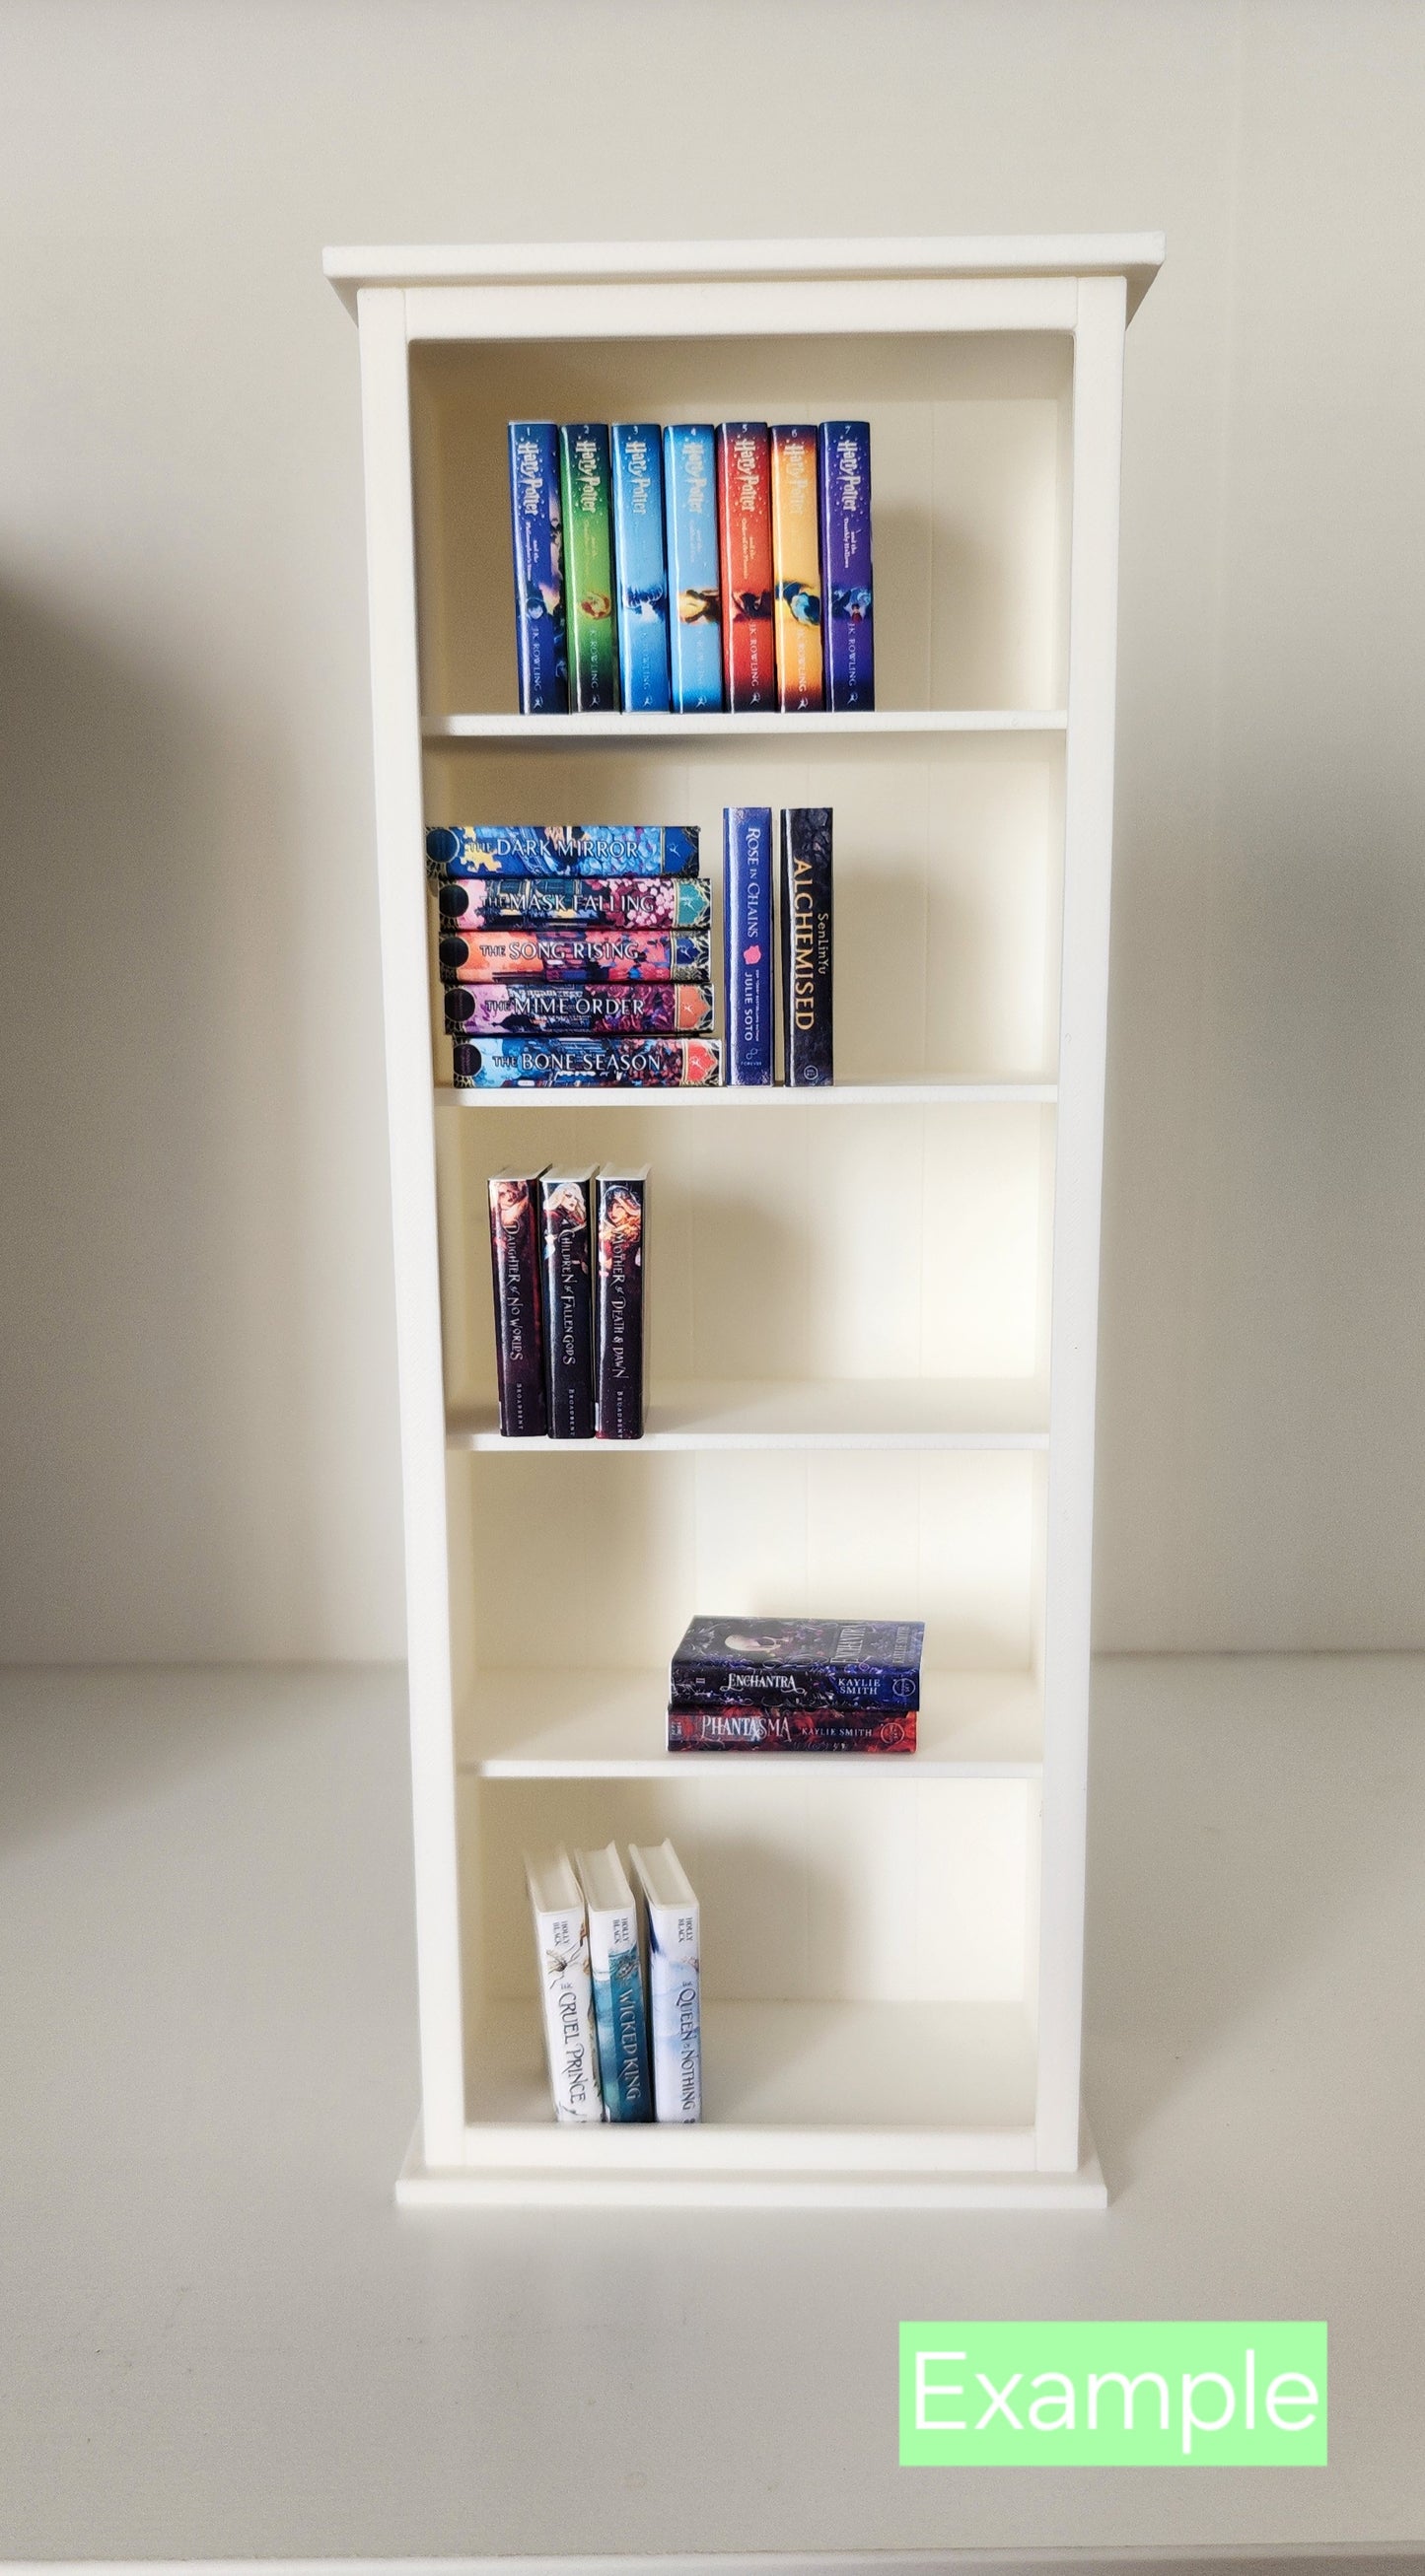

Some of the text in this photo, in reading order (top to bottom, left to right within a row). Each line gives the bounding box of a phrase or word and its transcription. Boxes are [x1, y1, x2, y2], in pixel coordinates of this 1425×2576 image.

[583, 425, 590, 435] 2
[633, 426, 639, 435] 3
[690, 427, 696, 436] 4
[743, 424, 748, 433] 5
[791, 429, 797, 439] 6
[845, 426, 851, 435] 7
[517, 442, 543, 515] Harry Potter
[575, 441, 597, 479] Harry
[625, 441, 647, 478] Harry
[734, 439, 759, 512] Harry Potter
[837, 440, 861, 512] Harry Potter
[575, 476, 601, 514] Potter
[626, 477, 651, 515] Potter
[532, 643, 542, 691] ROWLING
[750, 642, 759, 687] ROWLING
[848, 642, 857, 687] ROWLING
[496, 839, 552, 857] DARK
[556, 840, 640, 858] MIRROR
[746, 827, 761, 866] ROSE
[480, 893, 655, 912] THE MASK FALLING
[747, 882, 760, 939] CHAINS
[480, 941, 639, 960] THE SONG RISING
[793, 856, 816, 1031] ALCHEMISED
[817, 913, 829, 975] SenLinYu
[485, 1000, 510, 1012] THE
[513, 998, 569, 1015] MIME
[575, 998, 644, 1015] ORDER
[744, 972, 753, 1041] JULIE SOTO
[493, 1053, 662, 1072] THE BONE SEASON
[504, 1219, 521, 1287] DAUGHTER
[558, 1228, 578, 1284] CHILDREN
[609, 1231, 625, 1287] MOTHER
[561, 1294, 576, 1334] FALLEN
[610, 1296, 627, 1334] DEATH
[509, 1317, 524, 1361] WORLDS
[562, 1334, 577, 1365] GODS
[611, 1346, 630, 1380] DAWN
[720, 1673, 806, 1694] ENCHANTRA
[837, 1678, 881, 1687] KAYLIE
[701, 1714, 793, 1743] PHANTASMA
[801, 1726, 837, 1737] KAYLIE
[839, 1726, 873, 1737] SMITH
[559, 1991, 580, 2045] CRUEL
[618, 1988, 638, 2054] WICKED
[677, 1987, 698, 2042] QUEEN
[561, 2043, 589, 2105] PRINCE
[616, 2056, 641, 2101] KING
[680, 2049, 699, 2111] NOTHING
